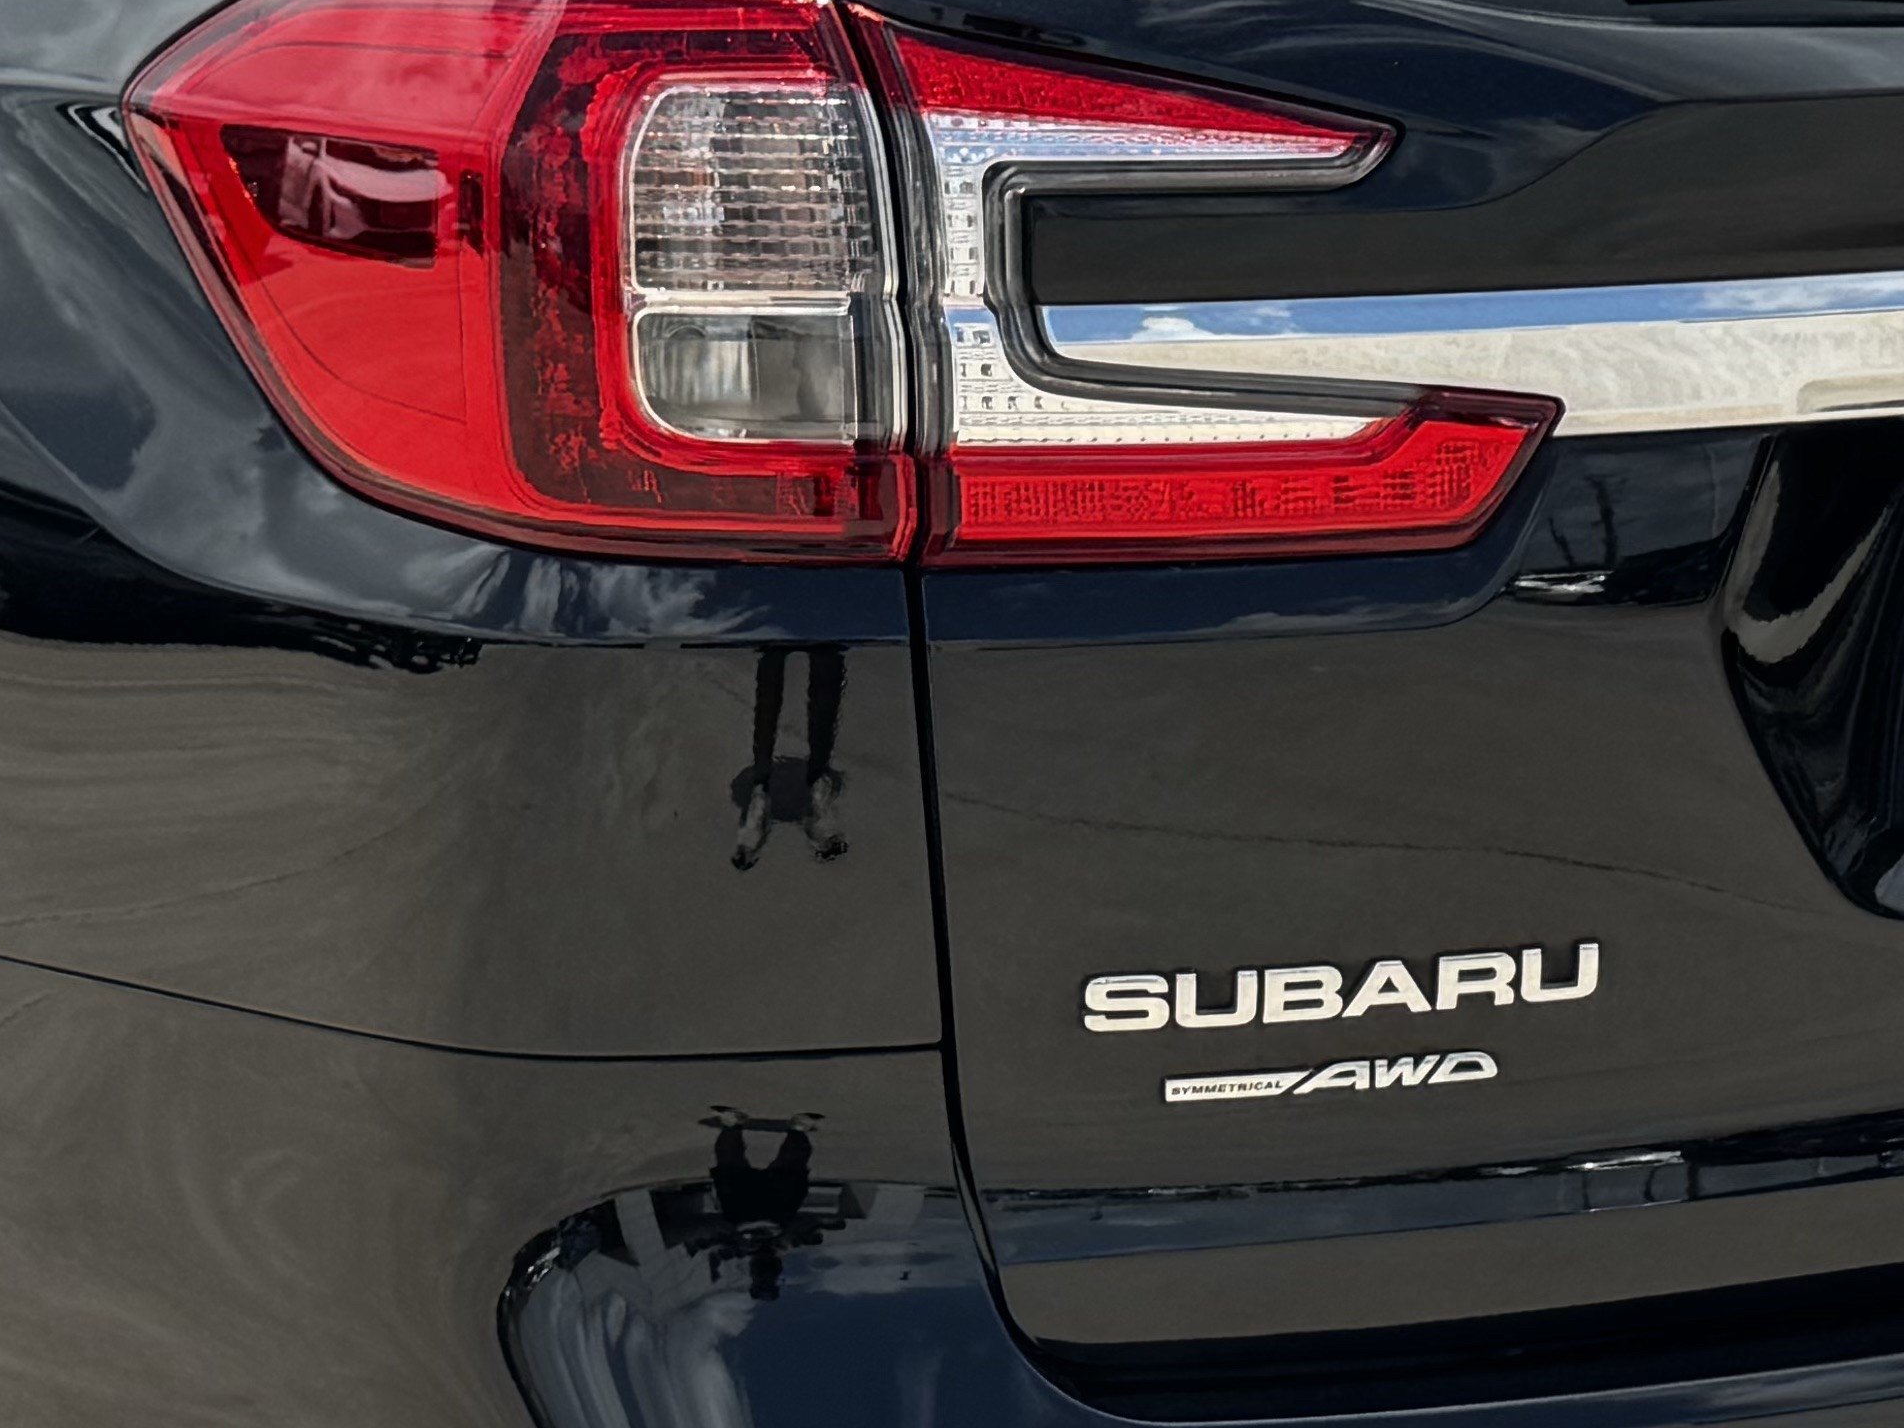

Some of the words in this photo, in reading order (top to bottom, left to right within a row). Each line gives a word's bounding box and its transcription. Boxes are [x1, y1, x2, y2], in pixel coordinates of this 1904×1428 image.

[1083, 942, 1600, 1033] SUBARU
[1171, 1079, 1284, 1096] SYMMETRICAL
[1293, 1051, 1497, 1095] AWD
